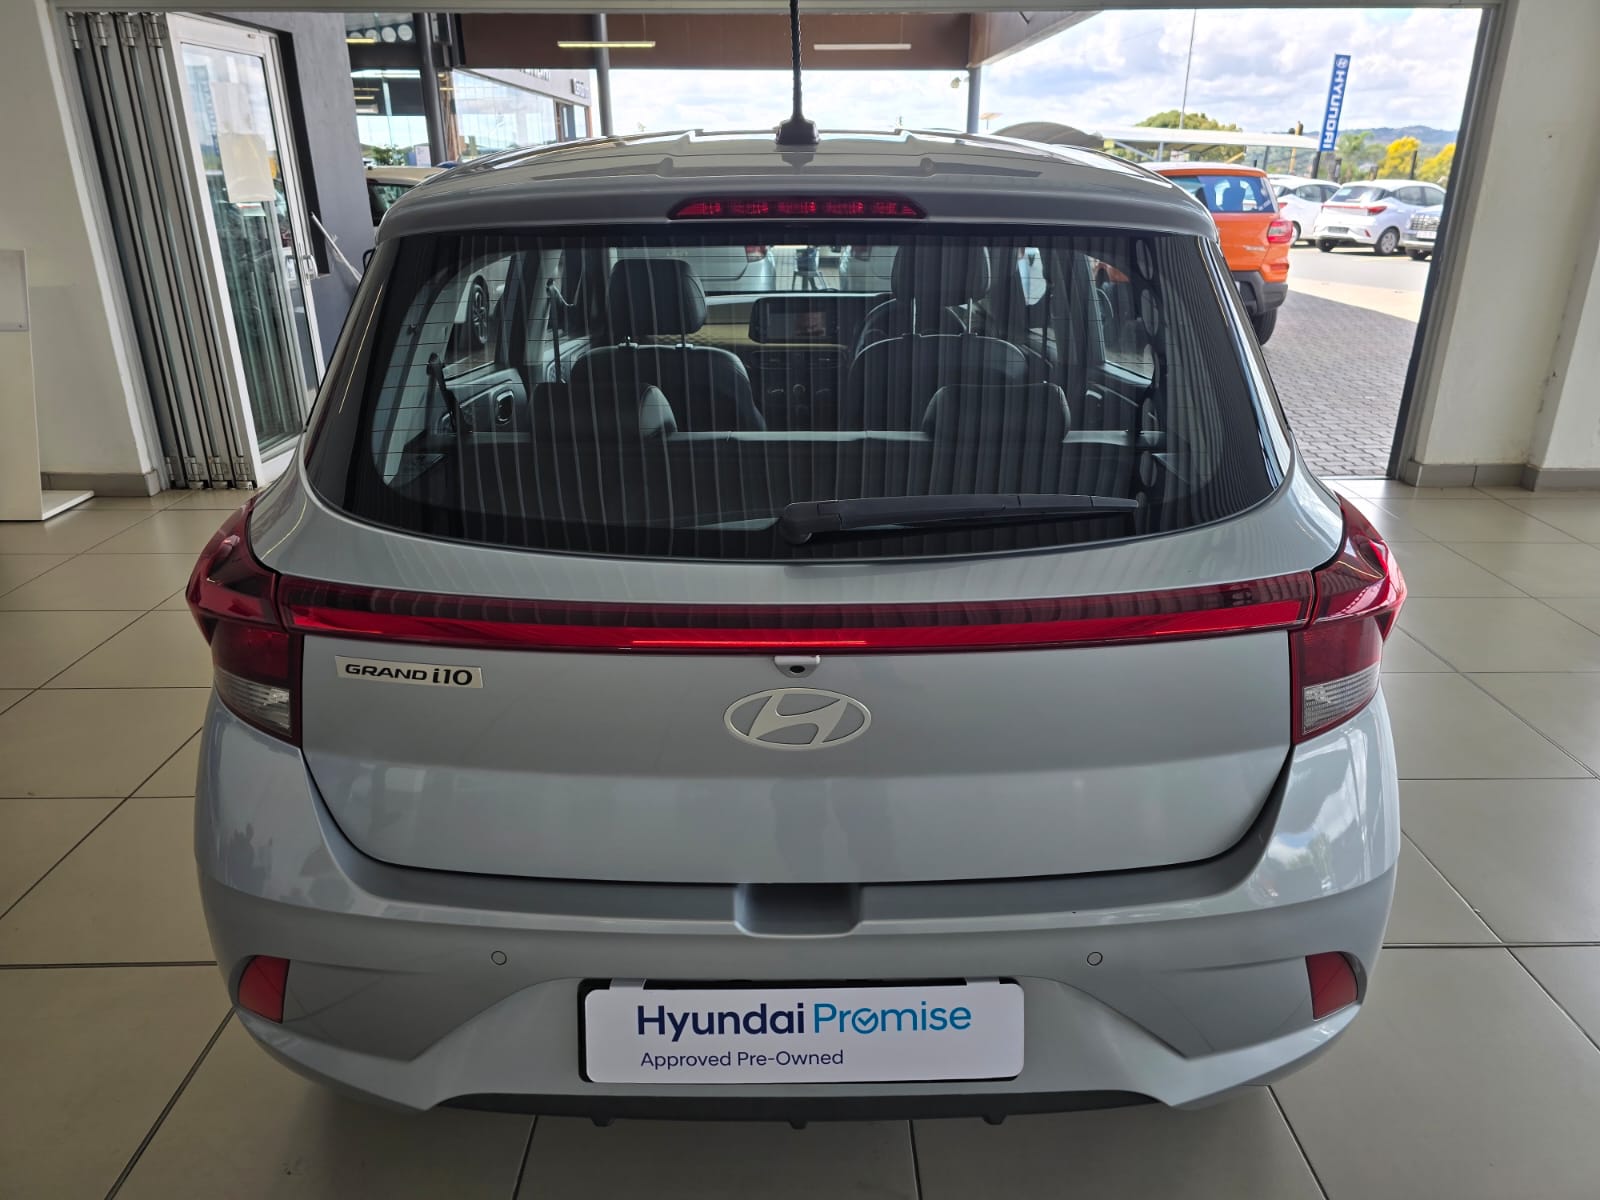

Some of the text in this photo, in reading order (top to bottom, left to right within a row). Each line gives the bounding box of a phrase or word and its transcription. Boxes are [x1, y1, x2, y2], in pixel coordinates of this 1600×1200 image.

[1322, 70, 1346, 149] HYUNDAI
[345, 664, 473, 686] GRAND i10
[638, 1001, 972, 1042] Hyundai Promise
[641, 1050, 844, 1070] Approved Pre-Owned
